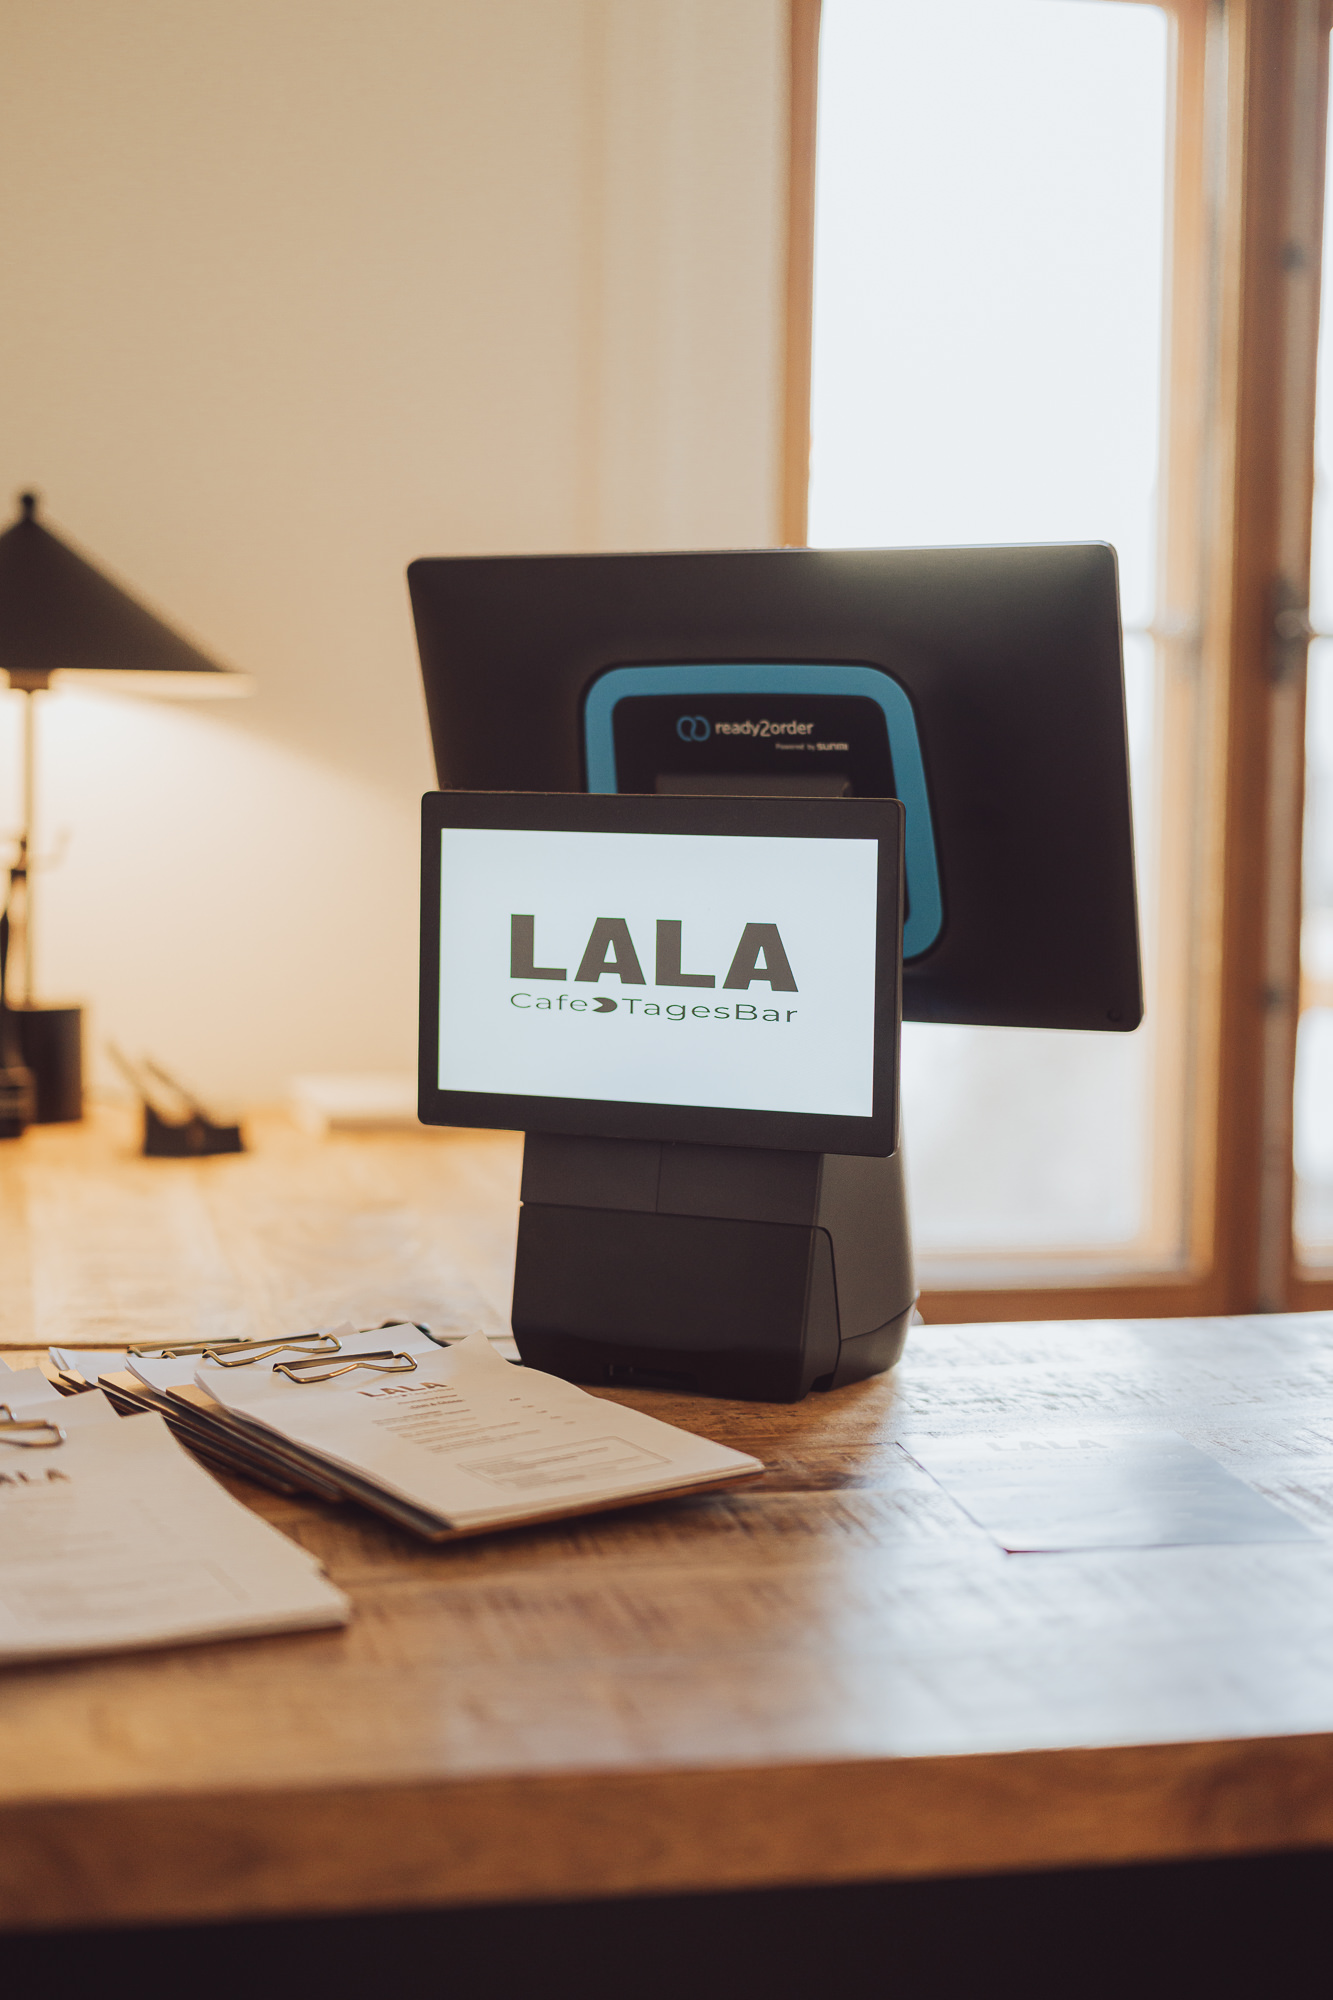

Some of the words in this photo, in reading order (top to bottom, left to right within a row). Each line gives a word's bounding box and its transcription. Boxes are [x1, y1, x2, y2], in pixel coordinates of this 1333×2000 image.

[715, 720, 814, 737] ready2order
[510, 914, 799, 992] LALA
[510, 993, 588, 1012] Cafe
[621, 998, 798, 1022] TagesBar
[356, 1382, 449, 1398] LALA
[985, 1439, 1109, 1452] LALA
